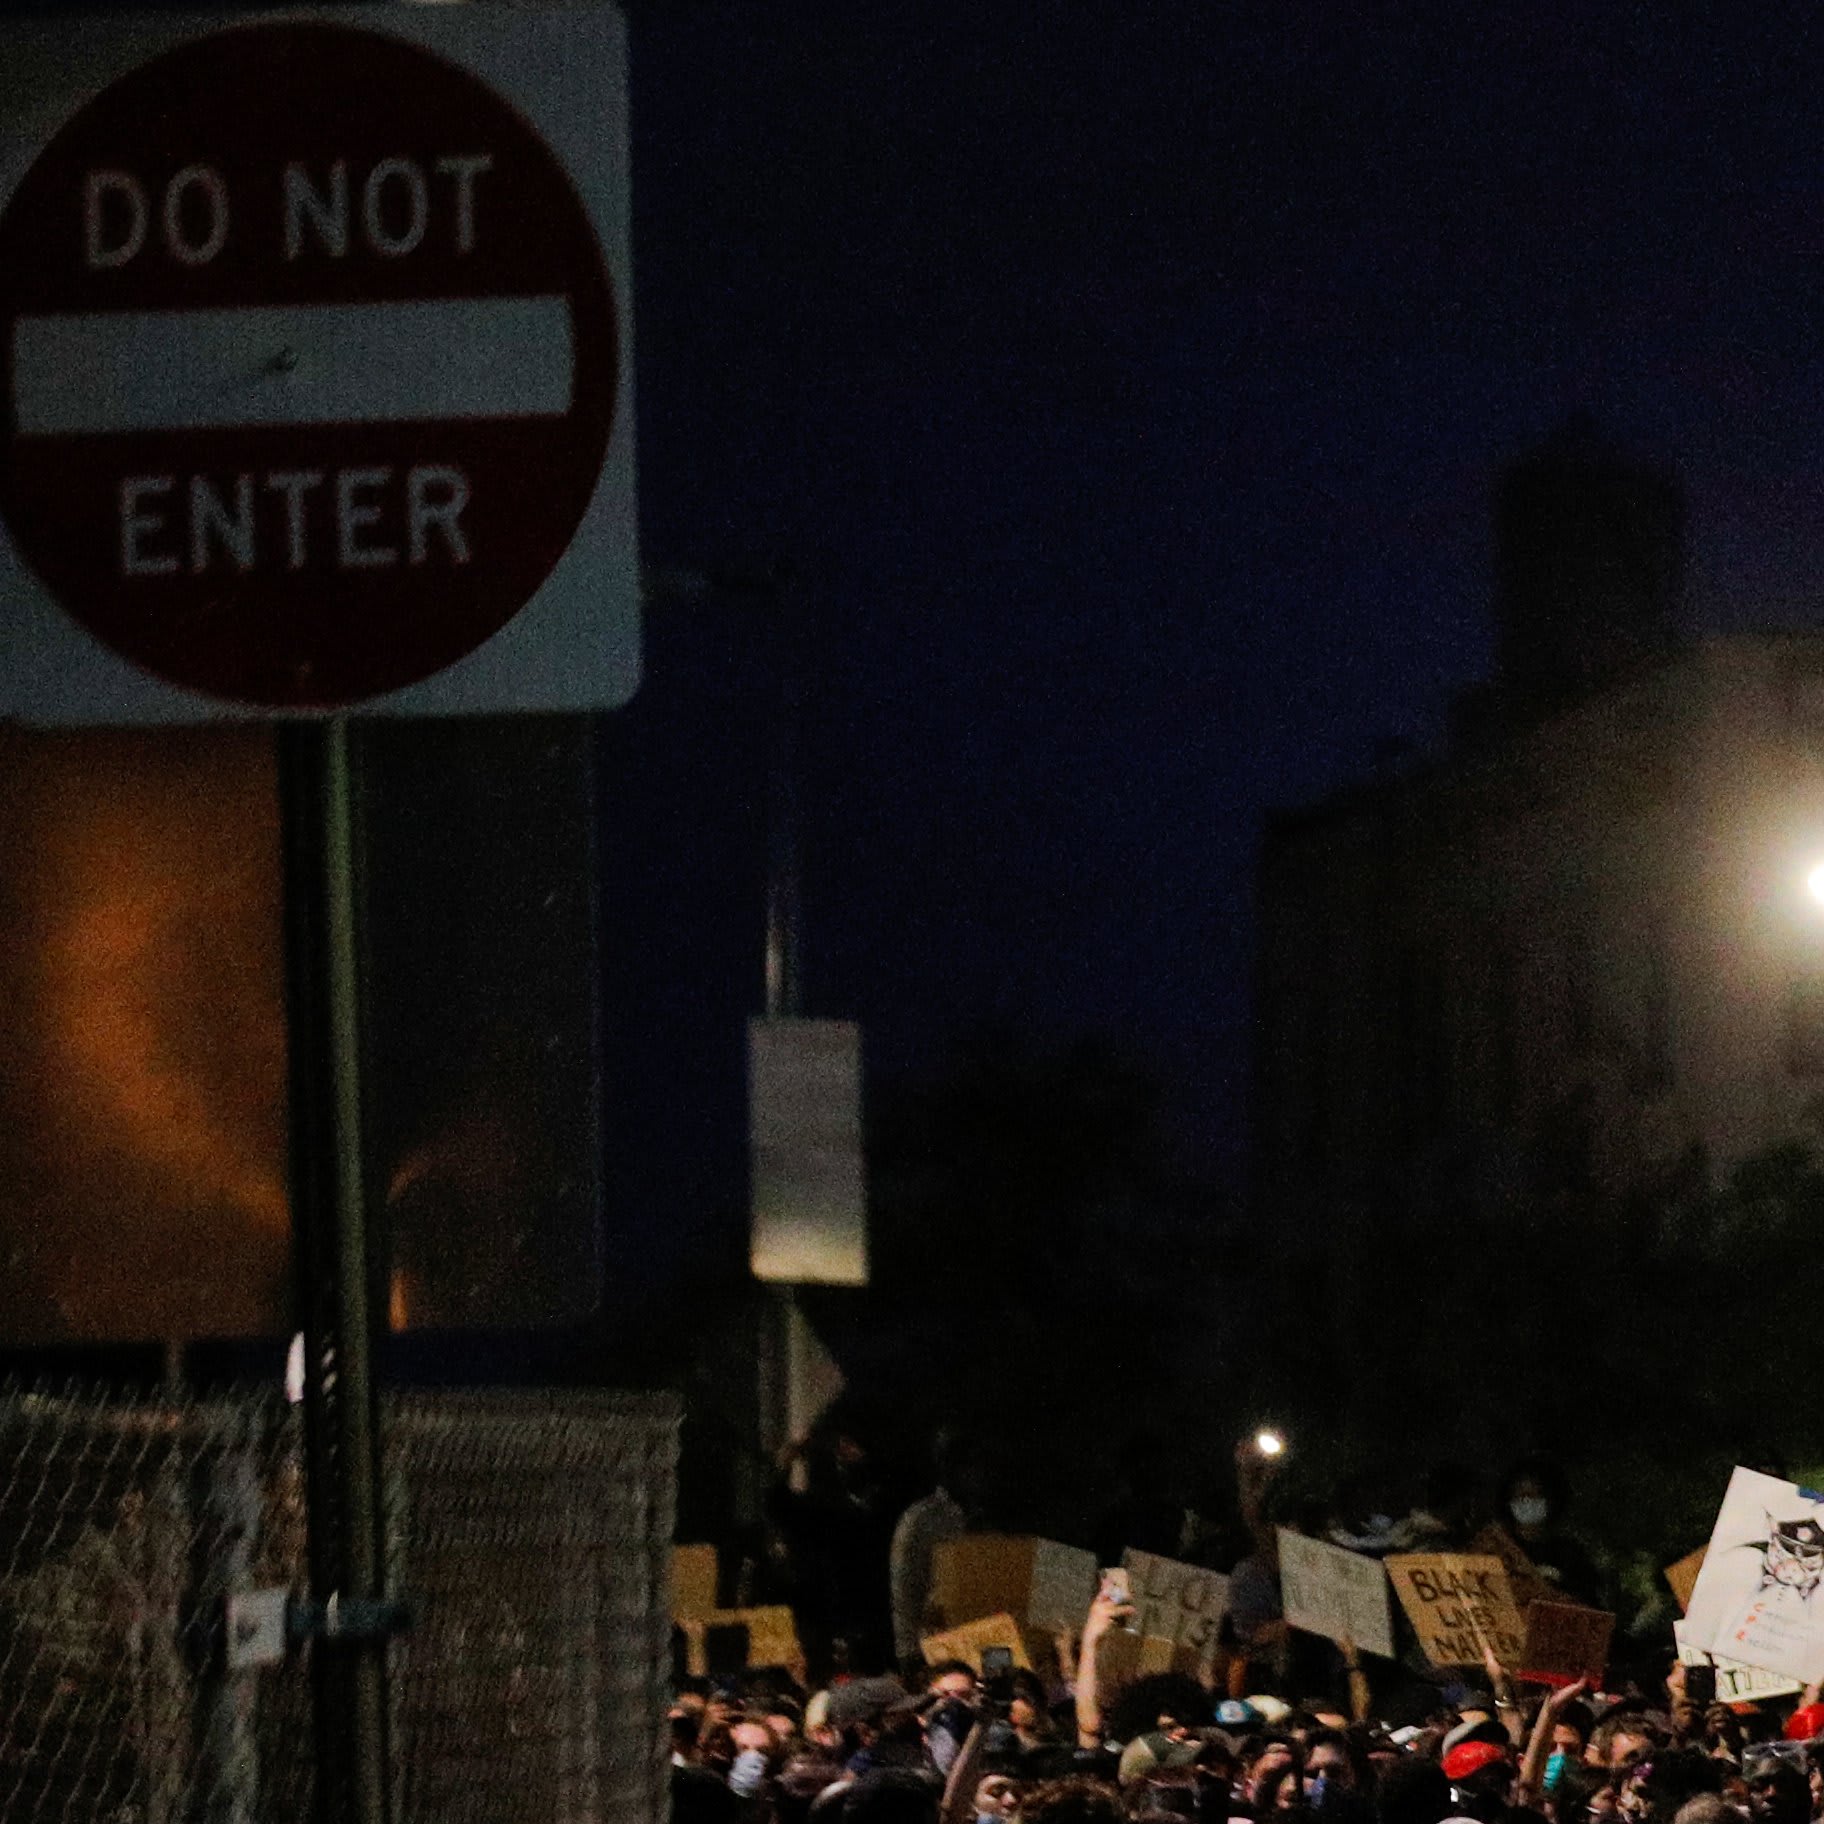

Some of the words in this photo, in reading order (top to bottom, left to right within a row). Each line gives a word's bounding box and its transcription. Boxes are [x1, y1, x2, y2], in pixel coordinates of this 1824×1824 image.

[83, 165, 231, 270] DO
[282, 153, 494, 260] NOT
[118, 464, 473, 576] ENTER
